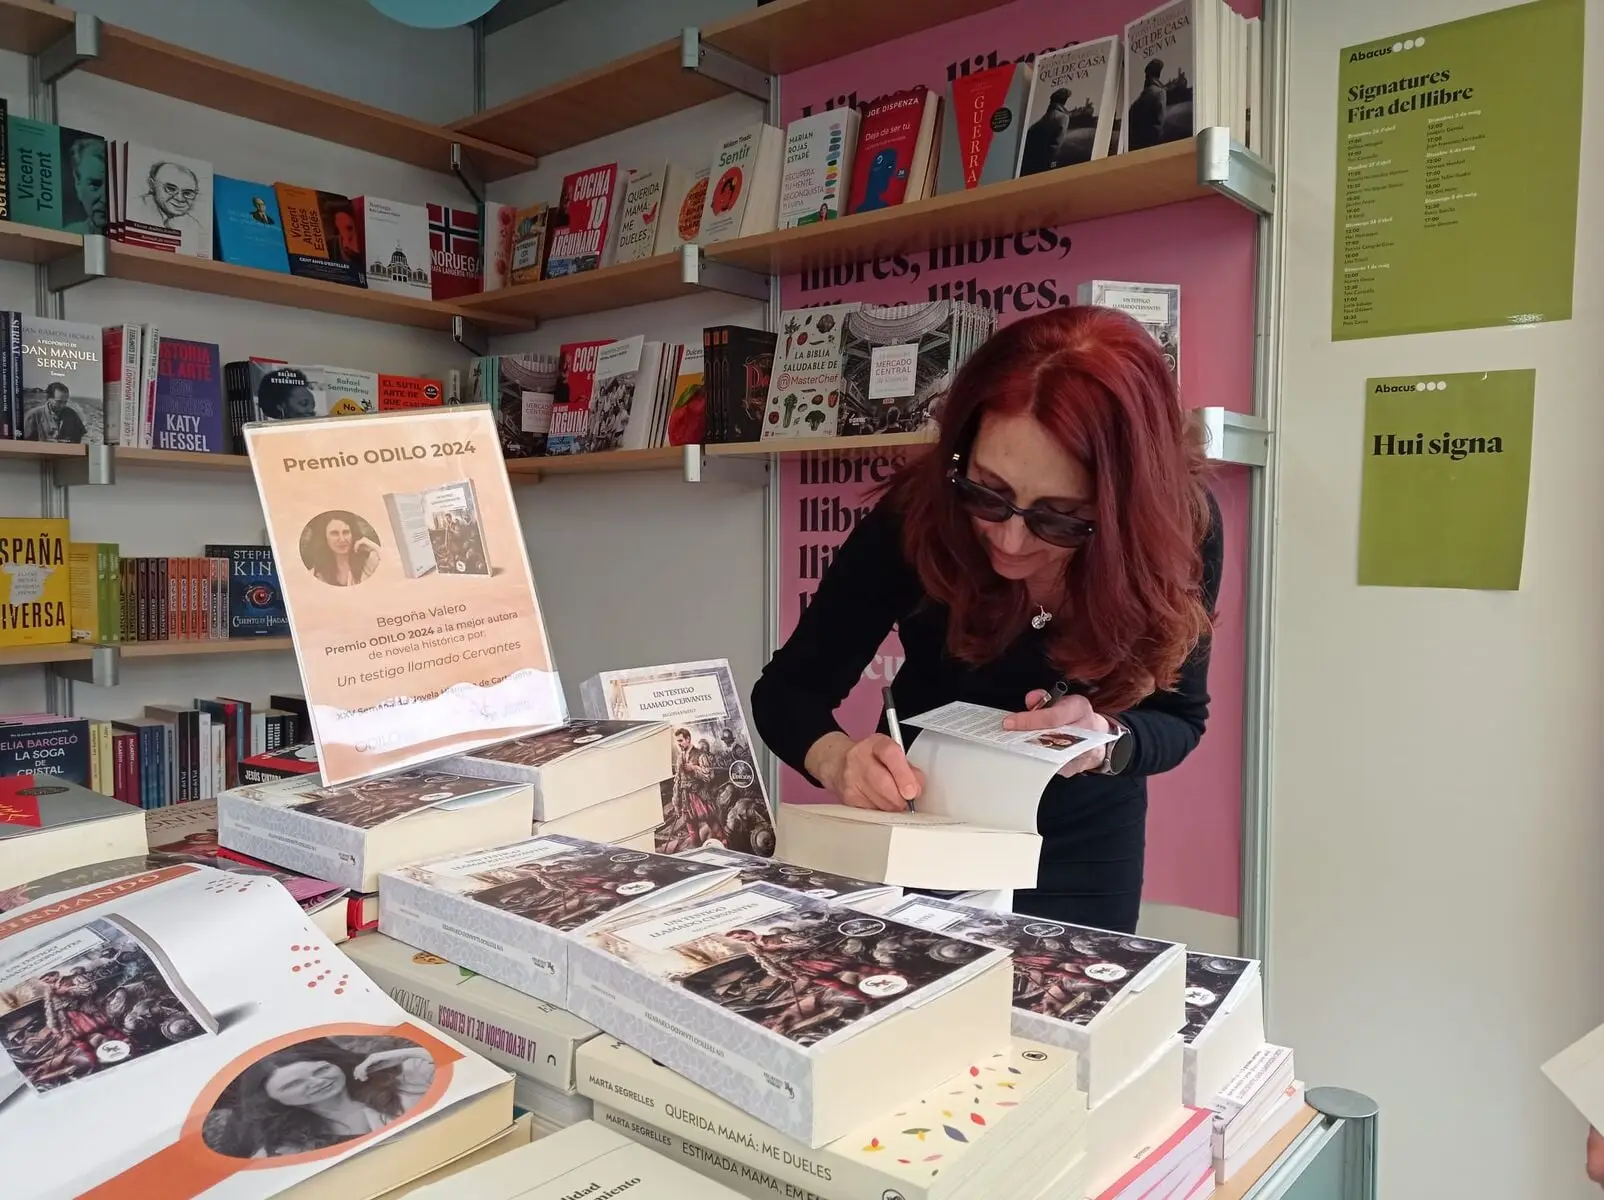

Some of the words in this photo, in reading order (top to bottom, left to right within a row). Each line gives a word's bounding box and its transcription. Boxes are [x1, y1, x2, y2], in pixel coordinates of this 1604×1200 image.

[1164, 15, 1190, 35] CASA
[1078, 55, 1106, 69] CASA
[1348, 46, 1393, 63] Abacus
[1348, 69, 1450, 102] Signatures
[866, 107, 881, 119] JOE
[882, 97, 920, 113] DISPENZA
[1348, 105, 1384, 123] Fira
[1388, 97, 1416, 115] del
[1420, 87, 1474, 109] llibre
[789, 131, 814, 144] MARIAN
[890, 126, 901, 135] ser
[967, 96, 985, 183] GUERRA
[718, 143, 751, 167] Sentir
[788, 143, 808, 154] ROJAS
[18, 146, 34, 199] Vicent
[36, 152, 53, 212] Torrent
[573, 169, 611, 202] COCINA
[627, 182, 660, 203] QUERIDA
[622, 220, 634, 232] ME
[37, 358, 79, 370] SERRAT
[51, 348, 98, 362] MANUEL
[573, 348, 599, 372] COCI
[806, 350, 830, 358] BIBLIA
[876, 359, 912, 368] MERCADO
[783, 361, 825, 372] SALUDABLE
[827, 360, 838, 369] DE
[875, 368, 912, 376] CENTRAL
[327, 384, 369, 395] Santandreu
[337, 378, 360, 386] Rafael
[396, 381, 421, 389] SUTIL
[791, 374, 838, 385] MasterChef
[1374, 384, 1416, 394] Abacus
[343, 403, 356, 412] No
[166, 414, 200, 433] KATY
[550, 408, 589, 434] ARGUIÑA
[160, 430, 210, 452] HESSEL
[1372, 433, 1424, 456] Hui
[1428, 432, 1503, 460] signa
[283, 450, 358, 473] Premio
[363, 445, 427, 465] ODILO
[432, 440, 476, 458] 2024
[0, 533, 64, 565] SPAÑA
[233, 562, 273, 576] KIN
[2, 602, 65, 630] IVERSA
[376, 608, 426, 628] Begoña
[428, 602, 467, 617] Valero
[324, 640, 367, 657] Premio
[369, 632, 406, 647] ODILO
[408, 626, 435, 640] 2024
[436, 626, 444, 634] a
[445, 623, 455, 632] la
[456, 617, 485, 632] mejor
[487, 611, 518, 624] autora
[368, 650, 383, 661] de
[385, 643, 420, 657] novela
[422, 632, 465, 649] histórica
[337, 675, 357, 688] Un
[360, 663, 405, 684] testigo
[408, 653, 460, 673] llamado
[462, 640, 521, 661] Cervantes
[639, 700, 674, 711] LLAMADO
[674, 694, 712, 705] CERVANTES
[653, 690, 665, 698] UN
[664, 687, 694, 697] TESTIGO
[0, 741, 24, 751] ELIA
[27, 734, 78, 748] BARCELÓ
[15, 752, 30, 761] LA
[33, 748, 65, 759] SOGA
[245, 770, 260, 782] JESÚS
[0, 874, 161, 933] IRMANDO
[438, 1004, 466, 1033] GLUCOSA
[467, 1016, 475, 1038] LA
[476, 1019, 485, 1042] DE
[485, 1022, 527, 1060] REVOLUCIÓN
[528, 1041, 537, 1064] LA
[588, 1074, 614, 1092] MARTA
[614, 1083, 655, 1108] SEGRELLES
[606, 1112, 630, 1130] MARTA
[630, 1123, 672, 1146] SEGRELLES
[665, 1103, 716, 1134] QUERIDA
[717, 1121, 759, 1153] MAMÁ:
[761, 1140, 781, 1160] ME
[783, 1147, 832, 1182] DUELES
[682, 1140, 739, 1175] ESTIMADA
[785, 1182, 805, 1200] EM
